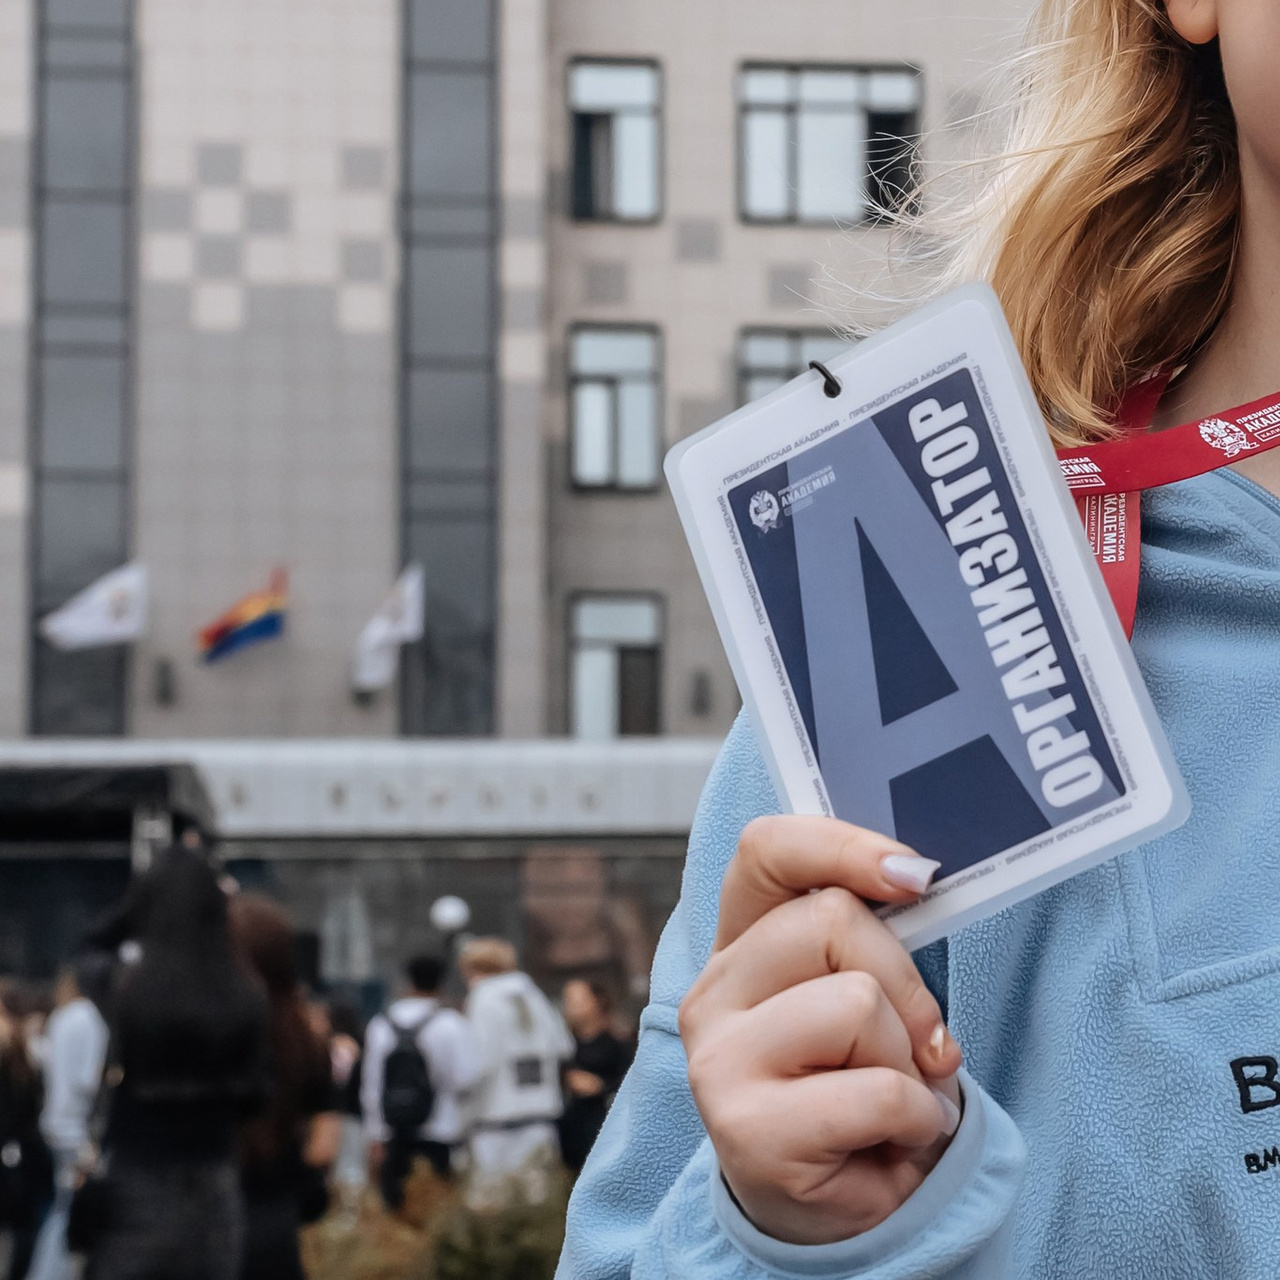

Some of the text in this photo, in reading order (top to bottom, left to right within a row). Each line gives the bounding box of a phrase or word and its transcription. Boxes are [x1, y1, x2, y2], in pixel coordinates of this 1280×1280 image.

[723, 352, 968, 486] ПРЕЗИДЕНТСКАЯ АКАДЕМИЯ ПРЕЗИДЕНТСКАЯ АКАДЕМИЯ
[715, 494, 741, 546] АКАДЕМИЯ
[780, 470, 837, 508] АКАДЕМИЯ
[1118, 493, 1126, 562] РЕЗИДЕНТСКАЯ
[732, 546, 767, 625] ПРЕЗИДЕНТСКАЯ
[908, 397, 1104, 808] ОРГАНИЗАТОР
